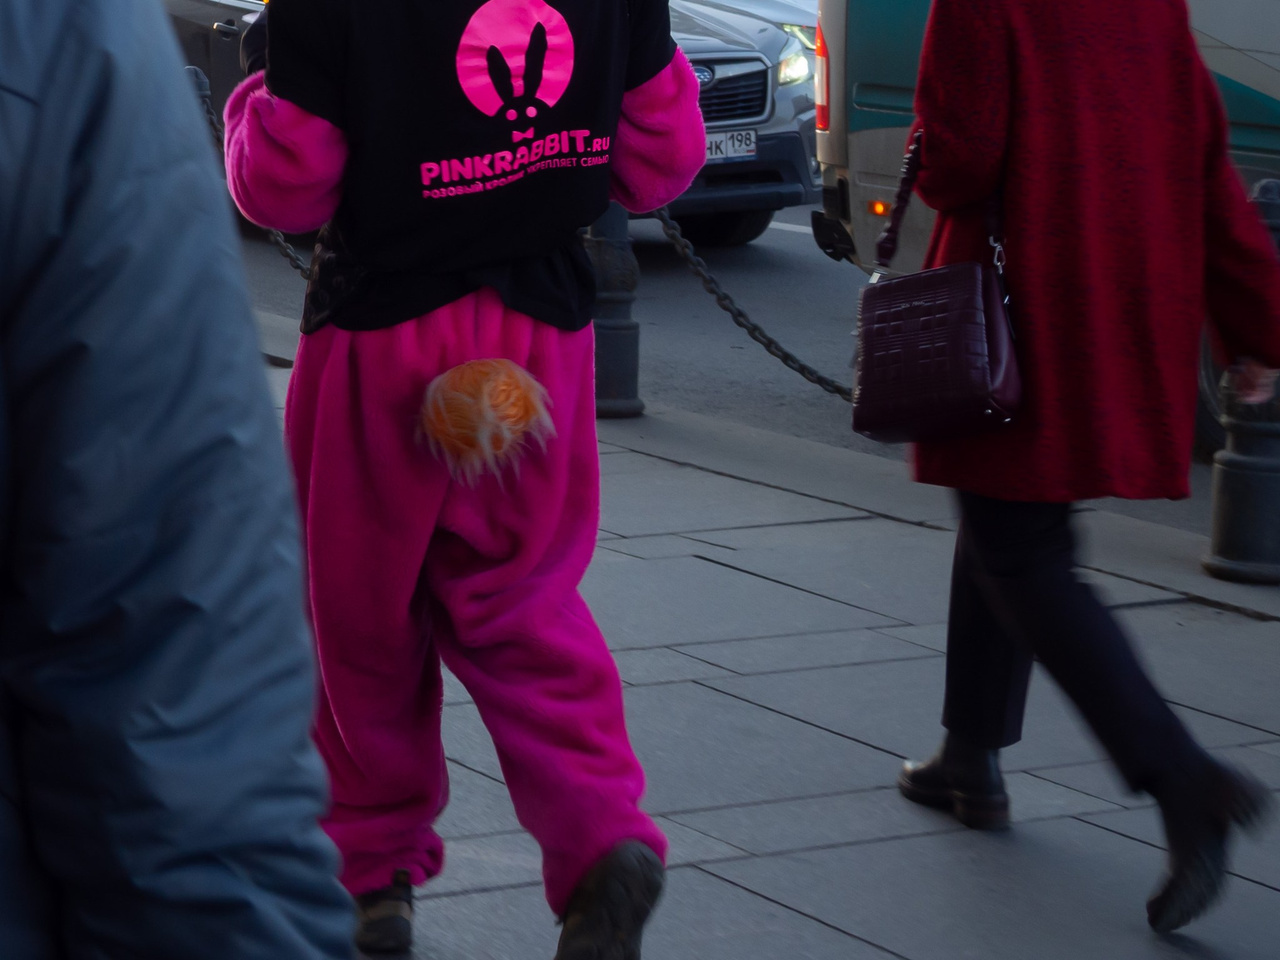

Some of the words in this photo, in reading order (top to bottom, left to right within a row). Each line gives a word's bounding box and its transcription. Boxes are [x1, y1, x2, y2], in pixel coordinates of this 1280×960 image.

[728, 132, 752, 148] 198
[420, 129, 610, 186] PINKRABBIT.RU
[526, 157, 577, 174] УКРЕПЛЯЕТ
[580, 154, 609, 167] СЕМЬЮ
